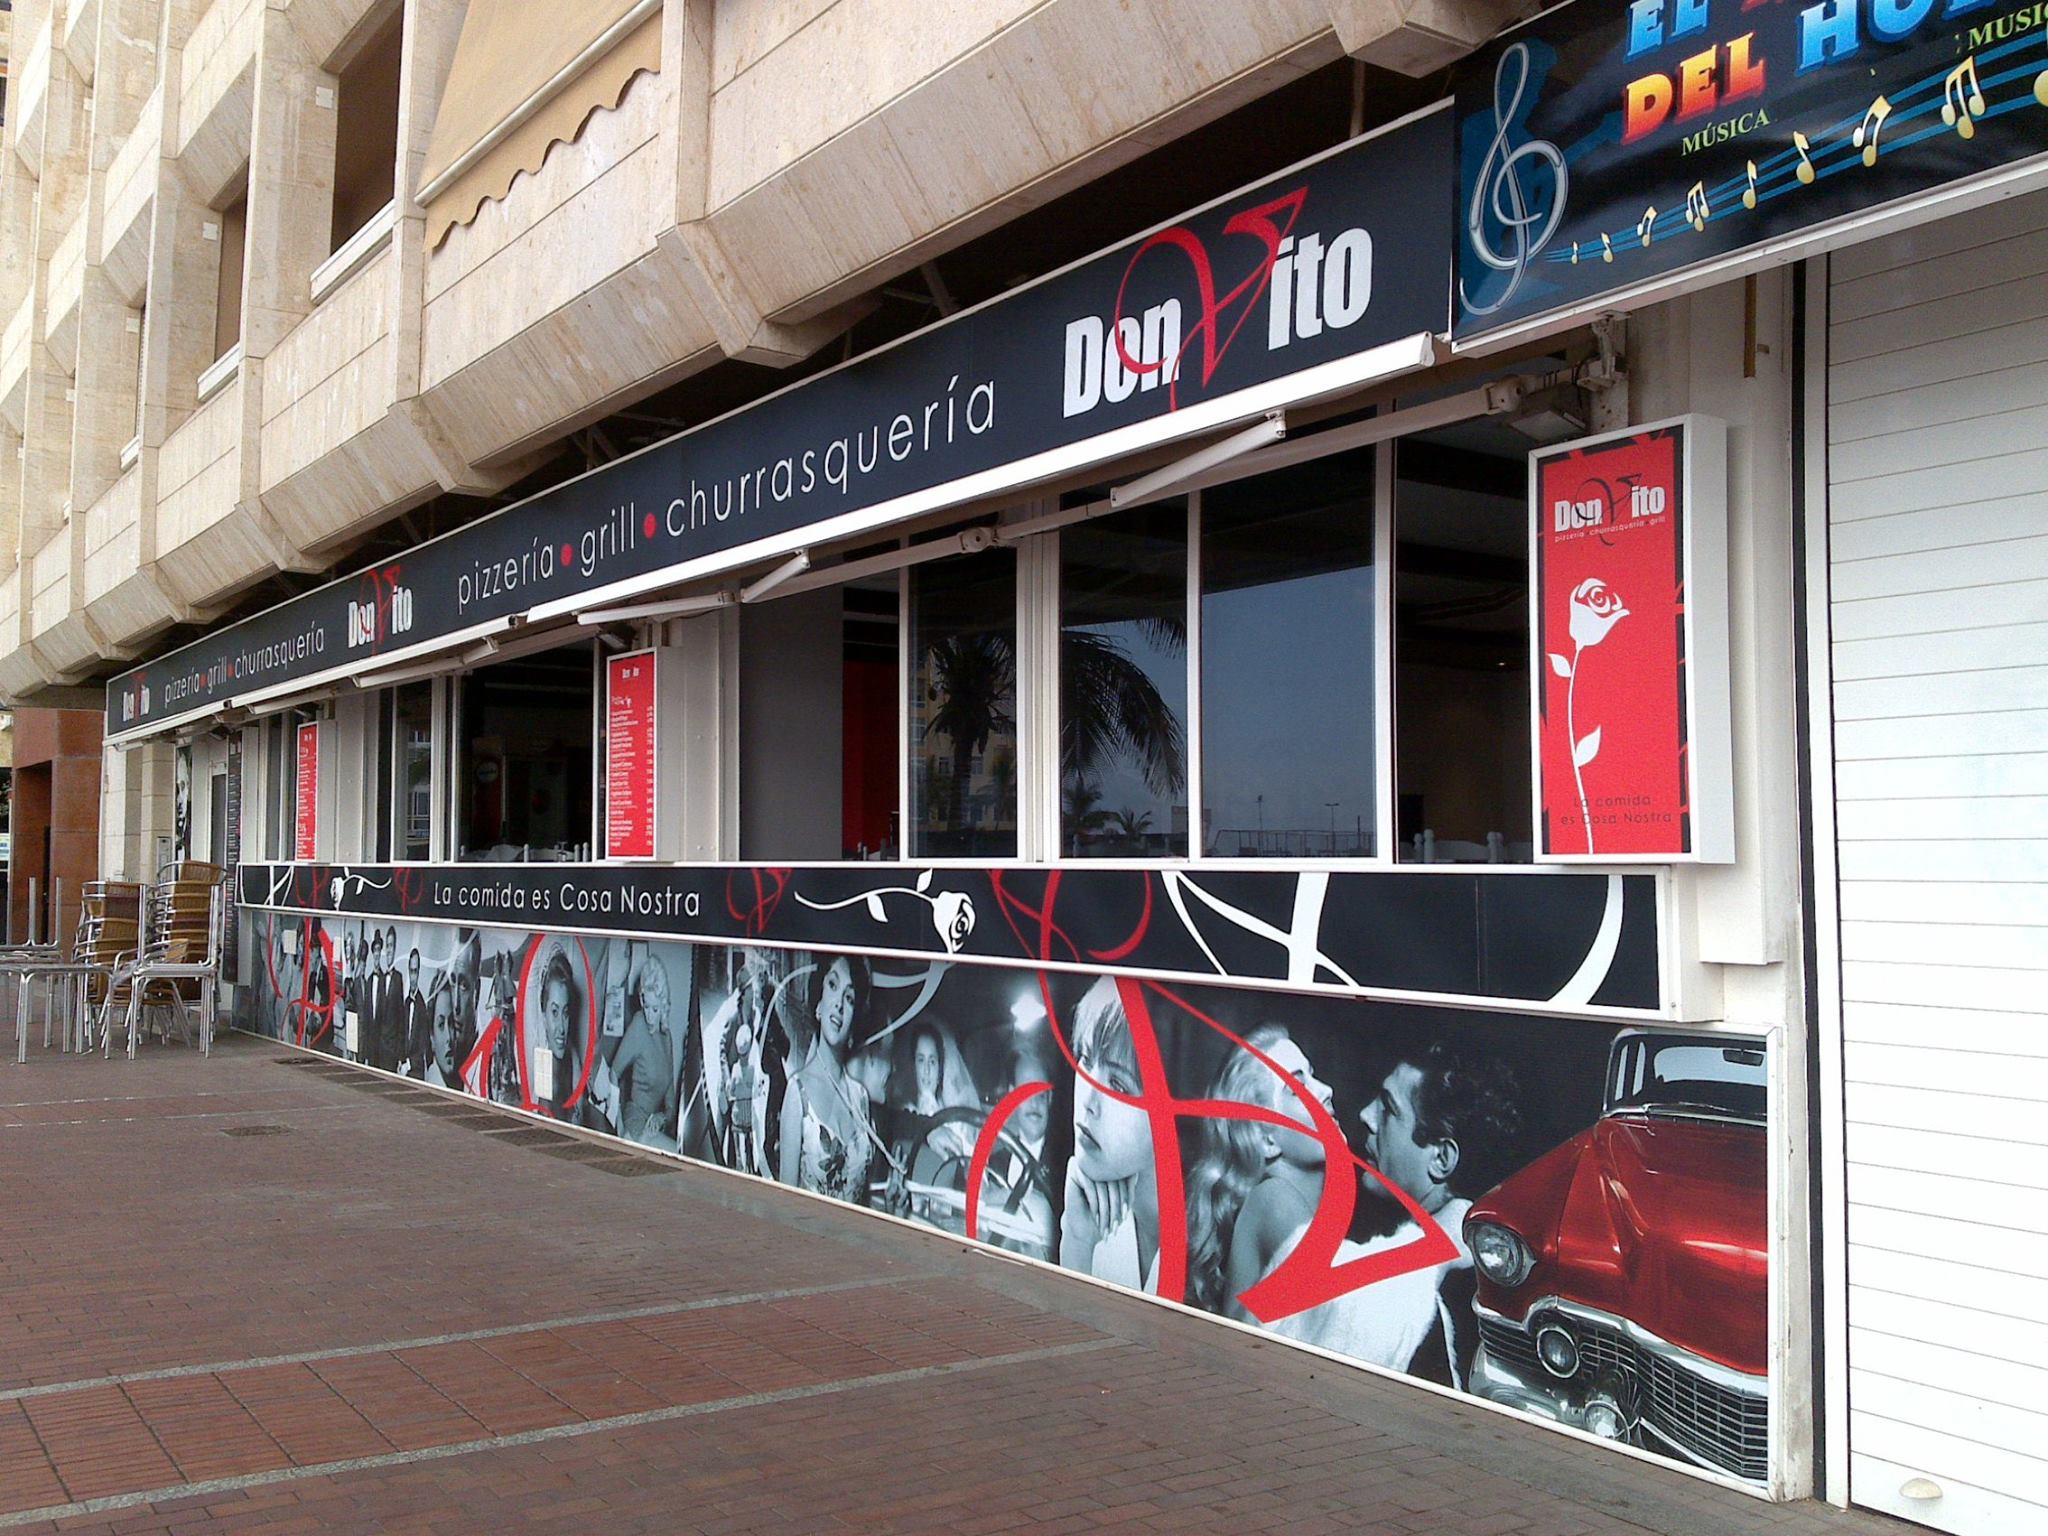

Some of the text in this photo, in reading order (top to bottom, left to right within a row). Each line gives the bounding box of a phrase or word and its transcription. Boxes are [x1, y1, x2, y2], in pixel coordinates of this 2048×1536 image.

[1622, 32, 1765, 144] DEL
[1681, 108, 1771, 157] MÚSICA
[1063, 298, 1182, 419] Don
[457, 374, 995, 615] pizzería grill churrasquería
[1554, 498, 1603, 532] Don
[348, 601, 375, 648] Don
[207, 656, 228, 695] grill
[434, 881, 700, 917] La comida es Cosa Nostra
